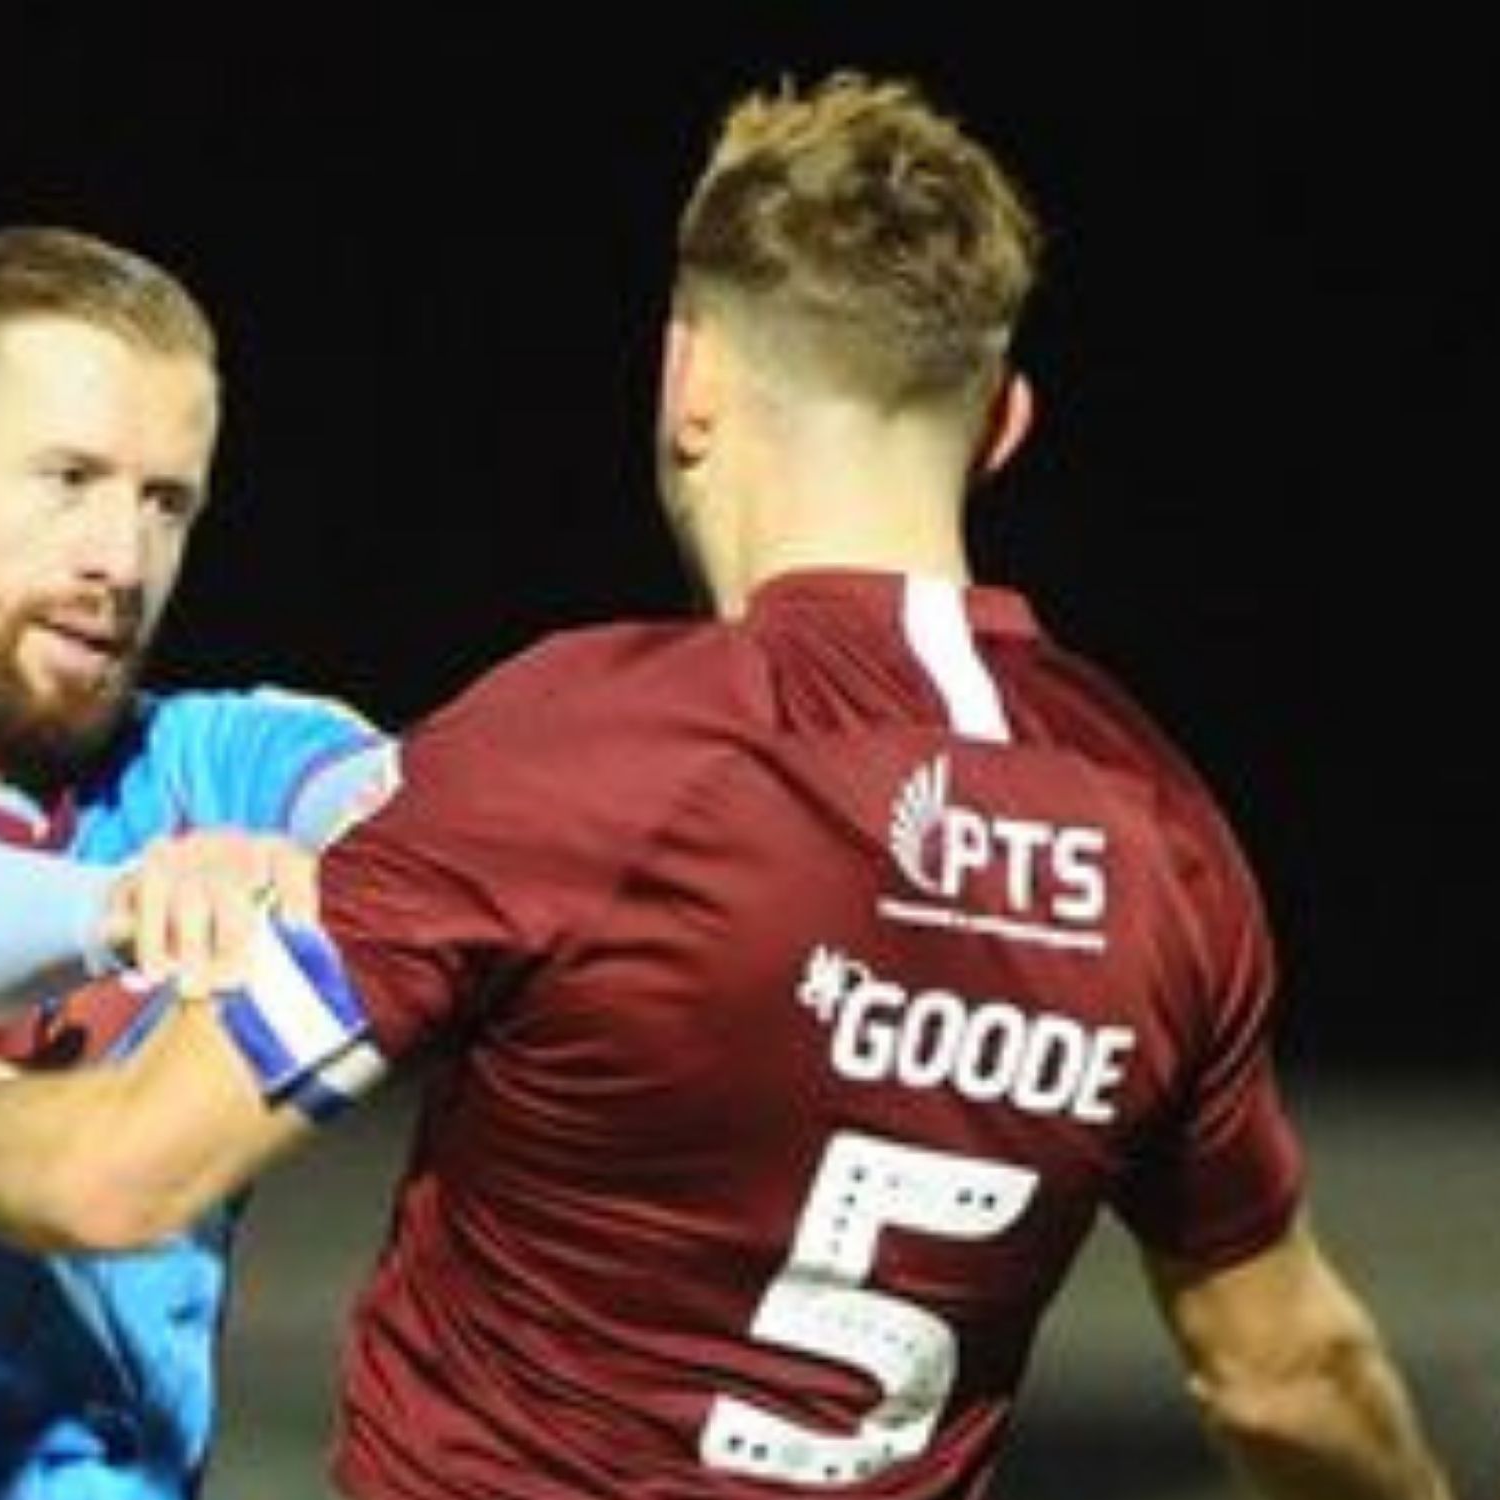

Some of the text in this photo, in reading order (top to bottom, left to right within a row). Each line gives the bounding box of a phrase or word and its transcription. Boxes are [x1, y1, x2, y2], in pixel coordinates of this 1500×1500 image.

[941, 807, 1105, 920] PTS
[831, 981, 1135, 1123] GOODE
[700, 1130, 1039, 1484] 5
